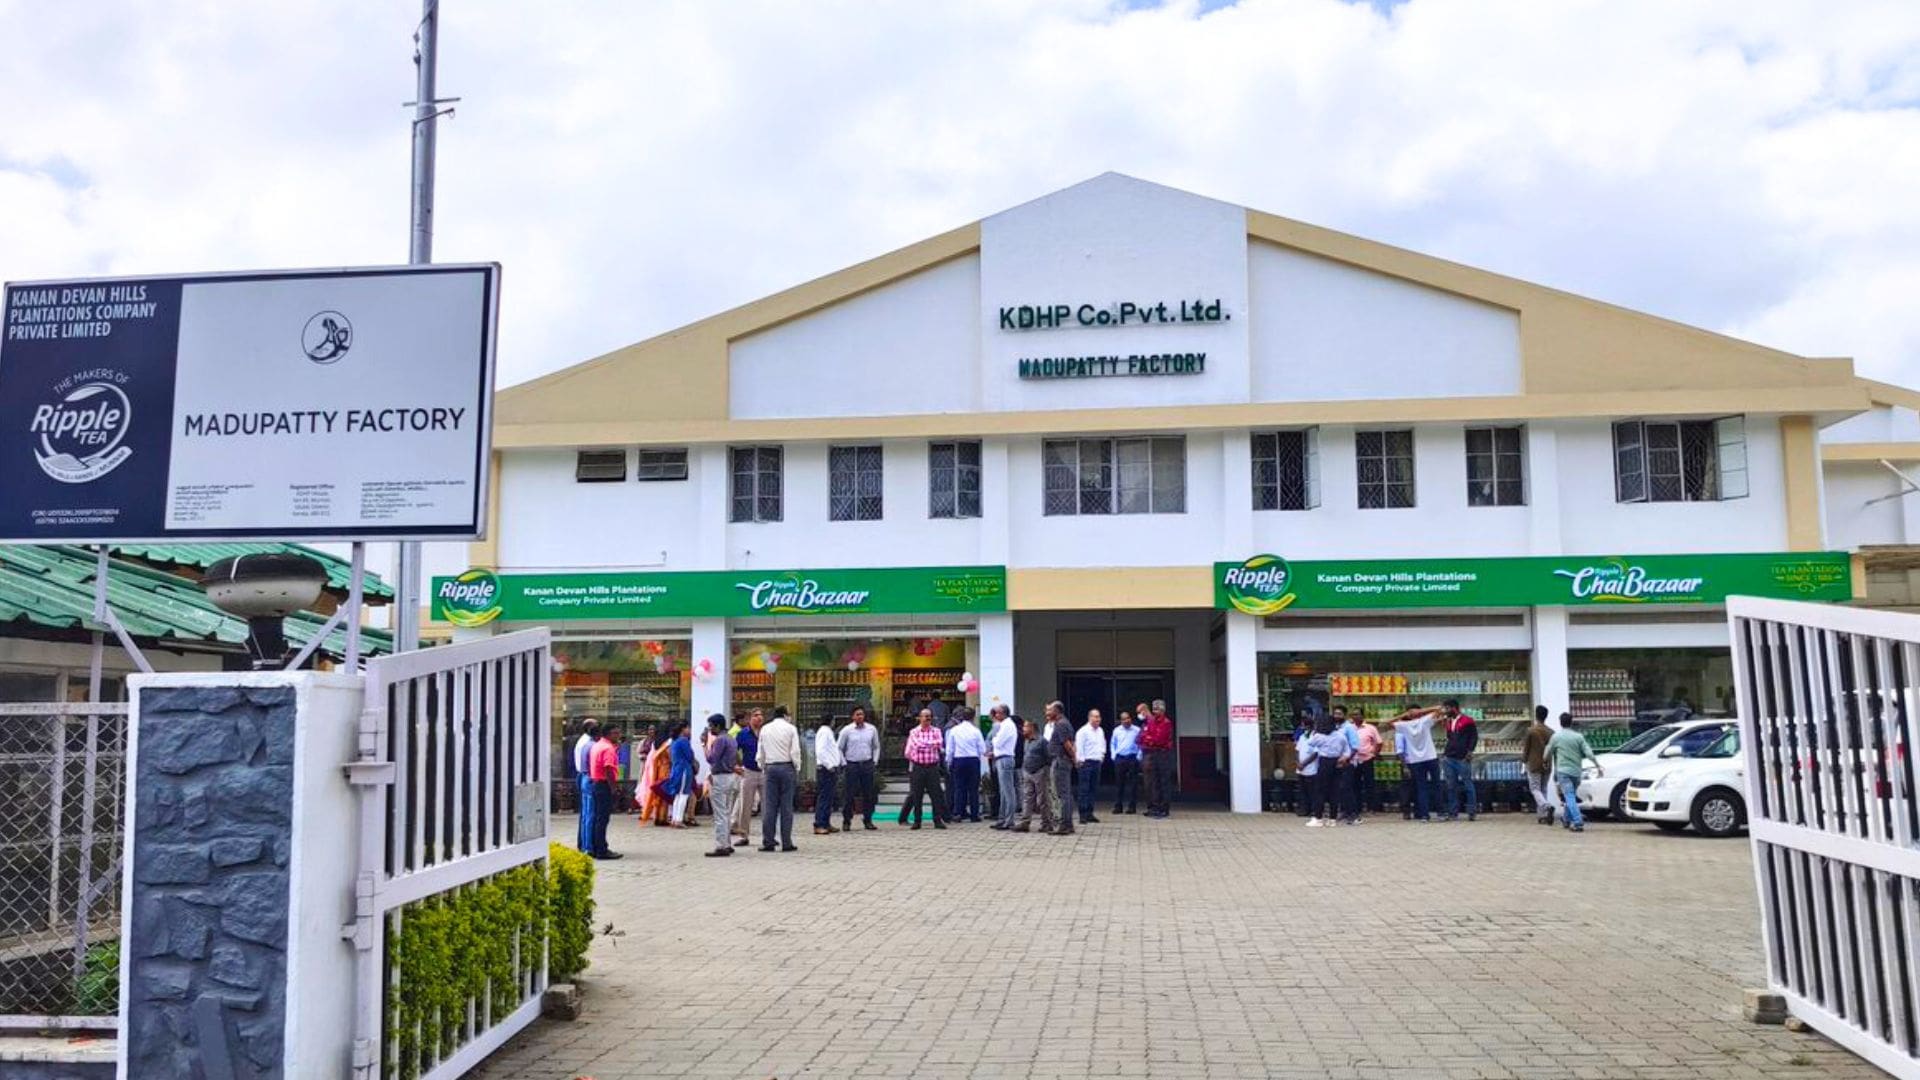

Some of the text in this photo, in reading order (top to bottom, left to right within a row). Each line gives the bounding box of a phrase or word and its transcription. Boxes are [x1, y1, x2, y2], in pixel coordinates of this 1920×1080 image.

[11, 285, 148, 307] KANAN DEVAN HILLS
[10, 302, 157, 324] PLANTATIONS COMPANY
[999, 305, 1071, 330] KDHP
[8, 321, 111, 340] PRIVATE LIMITED
[1018, 353, 1206, 378] MADUPATTY FACTORY
[54, 368, 130, 394] THE MAKERS OF
[30, 401, 121, 439] Ripple
[184, 407, 466, 436] MADUPATTY FACTORY
[80, 430, 108, 445] TEA
[1224, 566, 1286, 590] Ripple
[1317, 571, 1477, 583] Kanan Devan Hills Plantations
[439, 581, 495, 602] Ripple
[523, 585, 667, 596] Kanan Devan Hills Plantations
[1259, 584, 1280, 593] TEA
[1335, 582, 1460, 594] Company Private Limited
[469, 596, 489, 606] TEA
[538, 595, 652, 606] Company Private Limited
